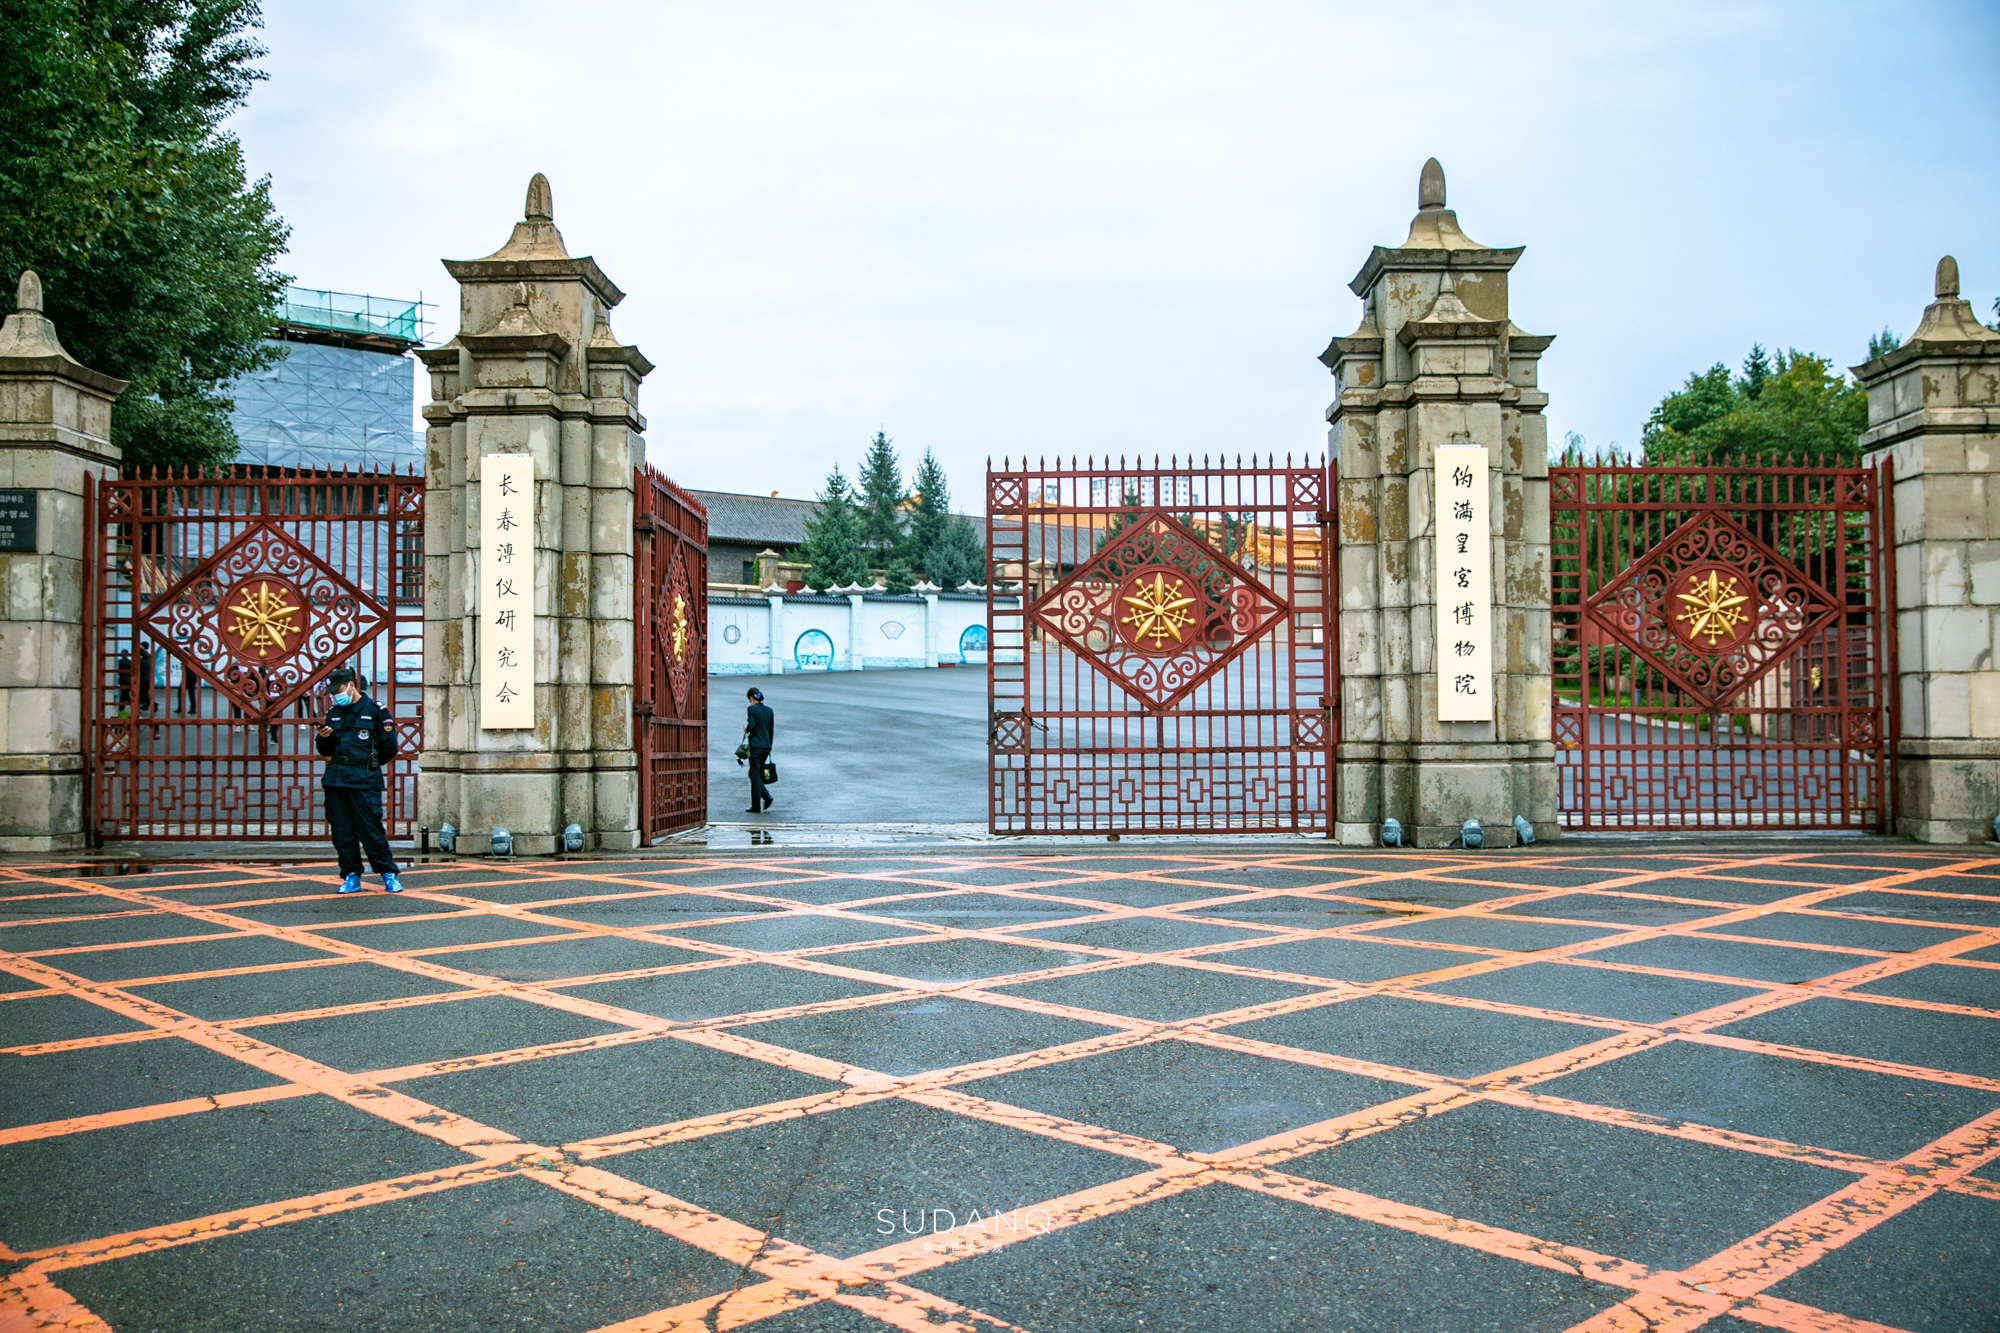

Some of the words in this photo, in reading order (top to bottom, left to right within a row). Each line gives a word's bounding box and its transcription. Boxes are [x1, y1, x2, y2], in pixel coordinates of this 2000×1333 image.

[495, 473, 519, 703] 长春溥仪研究会
